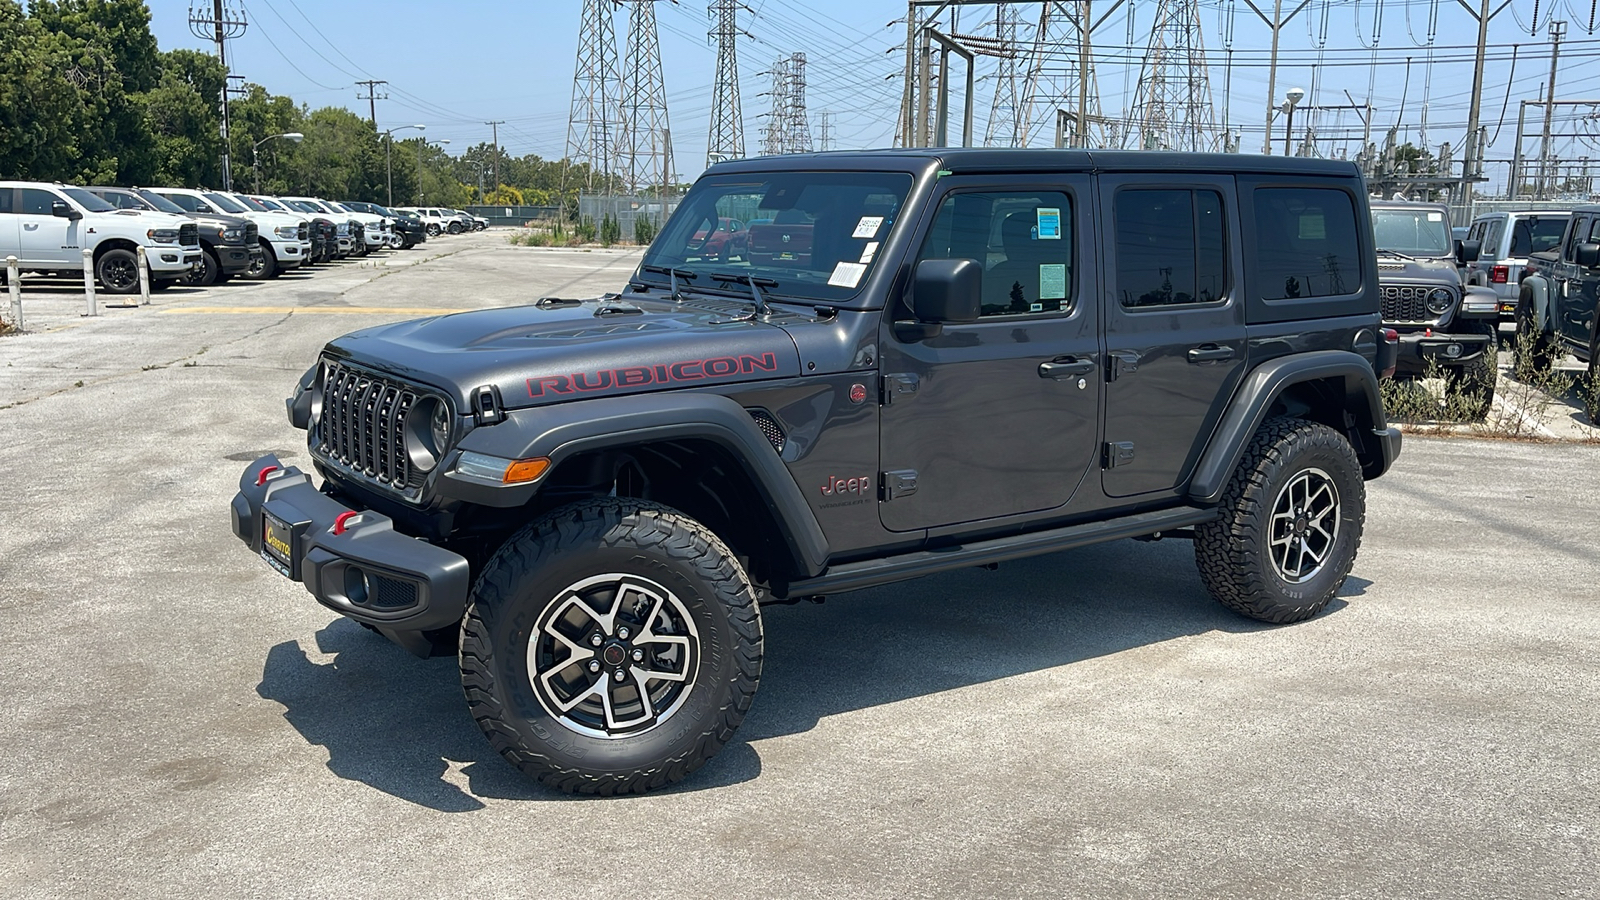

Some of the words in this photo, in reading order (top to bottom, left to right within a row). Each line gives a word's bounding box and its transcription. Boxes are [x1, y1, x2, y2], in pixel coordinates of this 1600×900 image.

[526, 352, 777, 398] RUBICON
[821, 475, 871, 496] Jeep
[818, 499, 864, 510] WRANGLER
